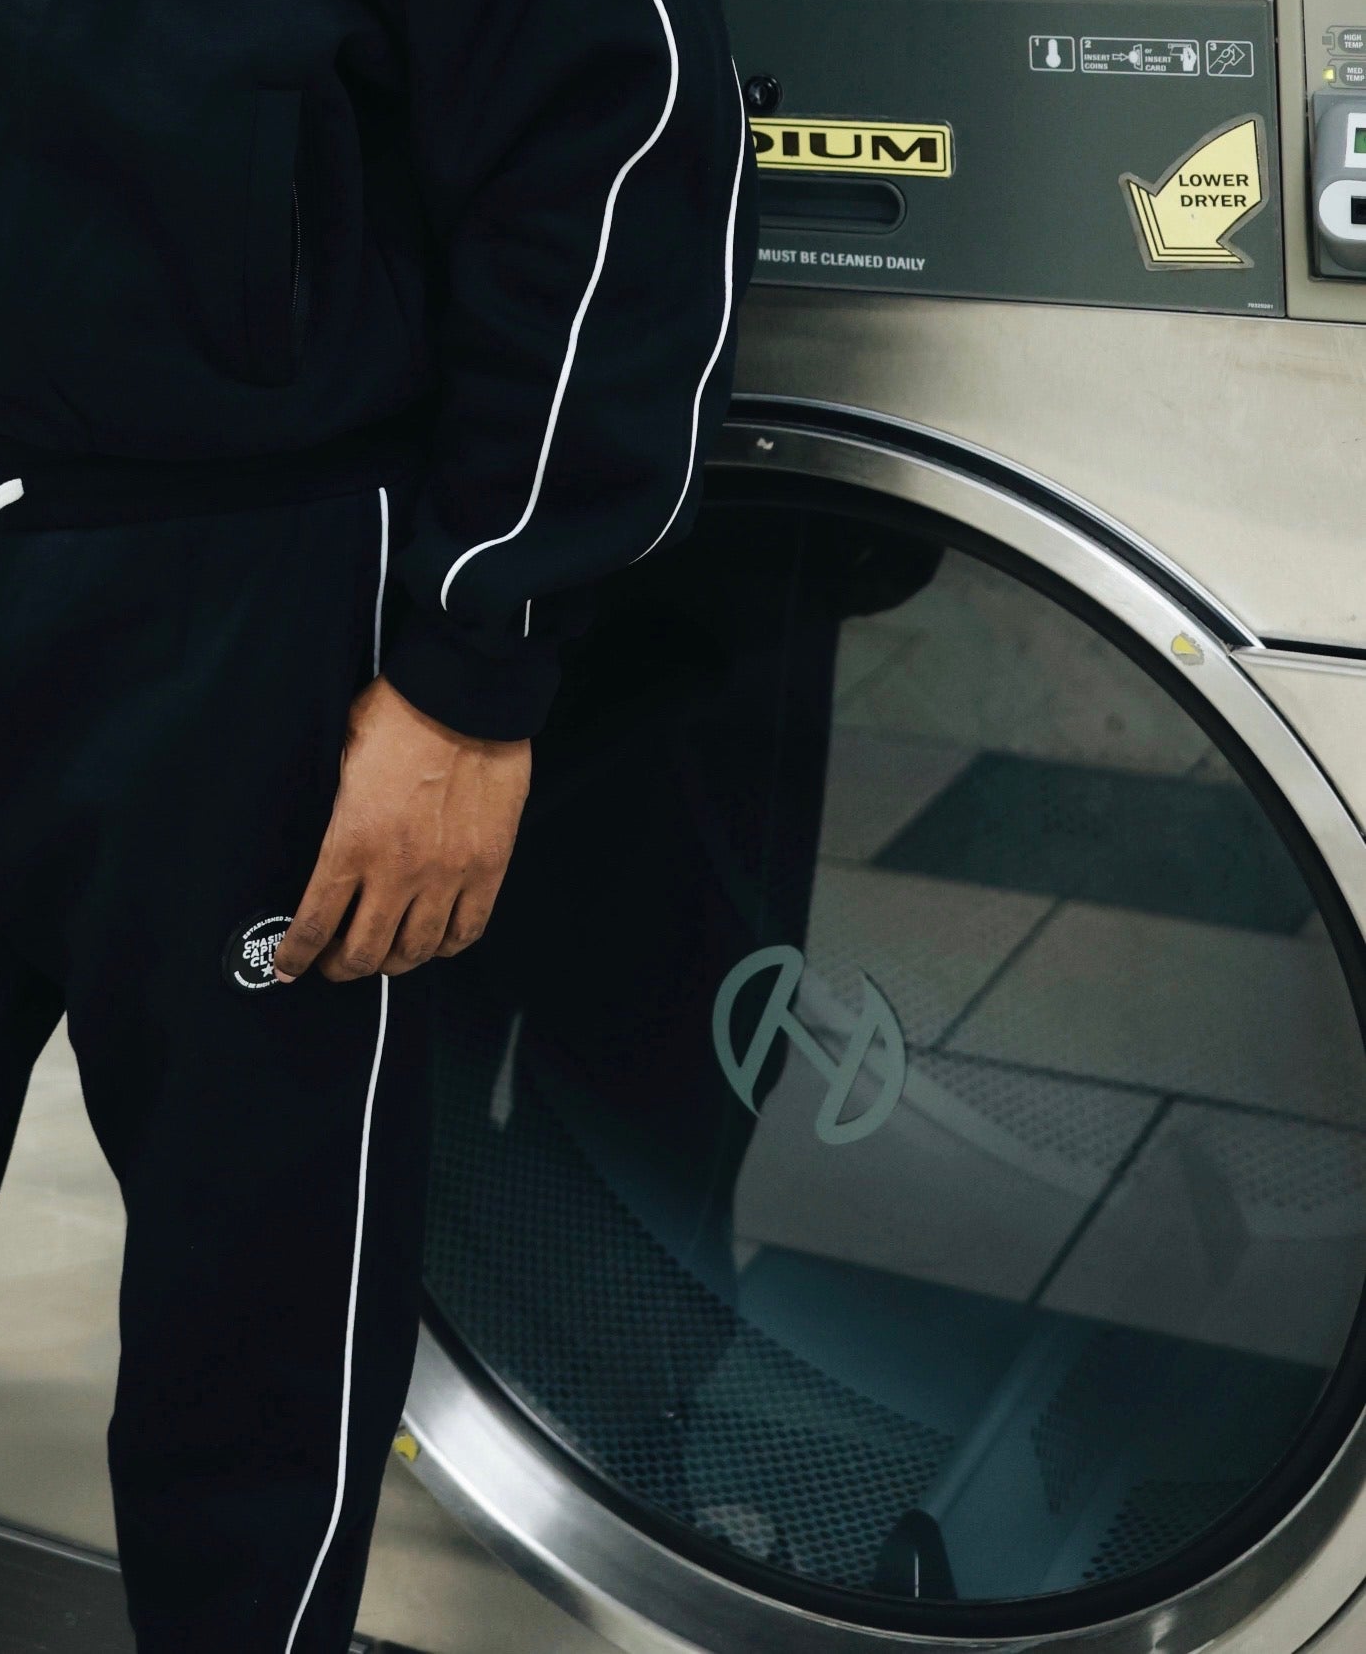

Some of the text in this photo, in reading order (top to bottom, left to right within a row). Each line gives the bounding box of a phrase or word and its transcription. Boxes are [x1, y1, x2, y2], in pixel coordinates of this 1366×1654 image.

[1084, 40, 1092, 48] 2
[1209, 42, 1217, 51] 3
[1344, 41, 1364, 49] TEMP
[1084, 53, 1110, 61] INSERT
[1084, 62, 1109, 70] COINS
[1145, 64, 1167, 72] CARD
[1346, 66, 1363, 74] MED
[1345, 74, 1365, 82] TEMP
[1179, 173, 1250, 187] LOWER
[1180, 194, 1247, 207] DRYER
[758, 248, 926, 271] MUST BE CLEANED DAILY
[244, 930, 286, 951] CHASIN
[242, 941, 281, 959] CAPIT
